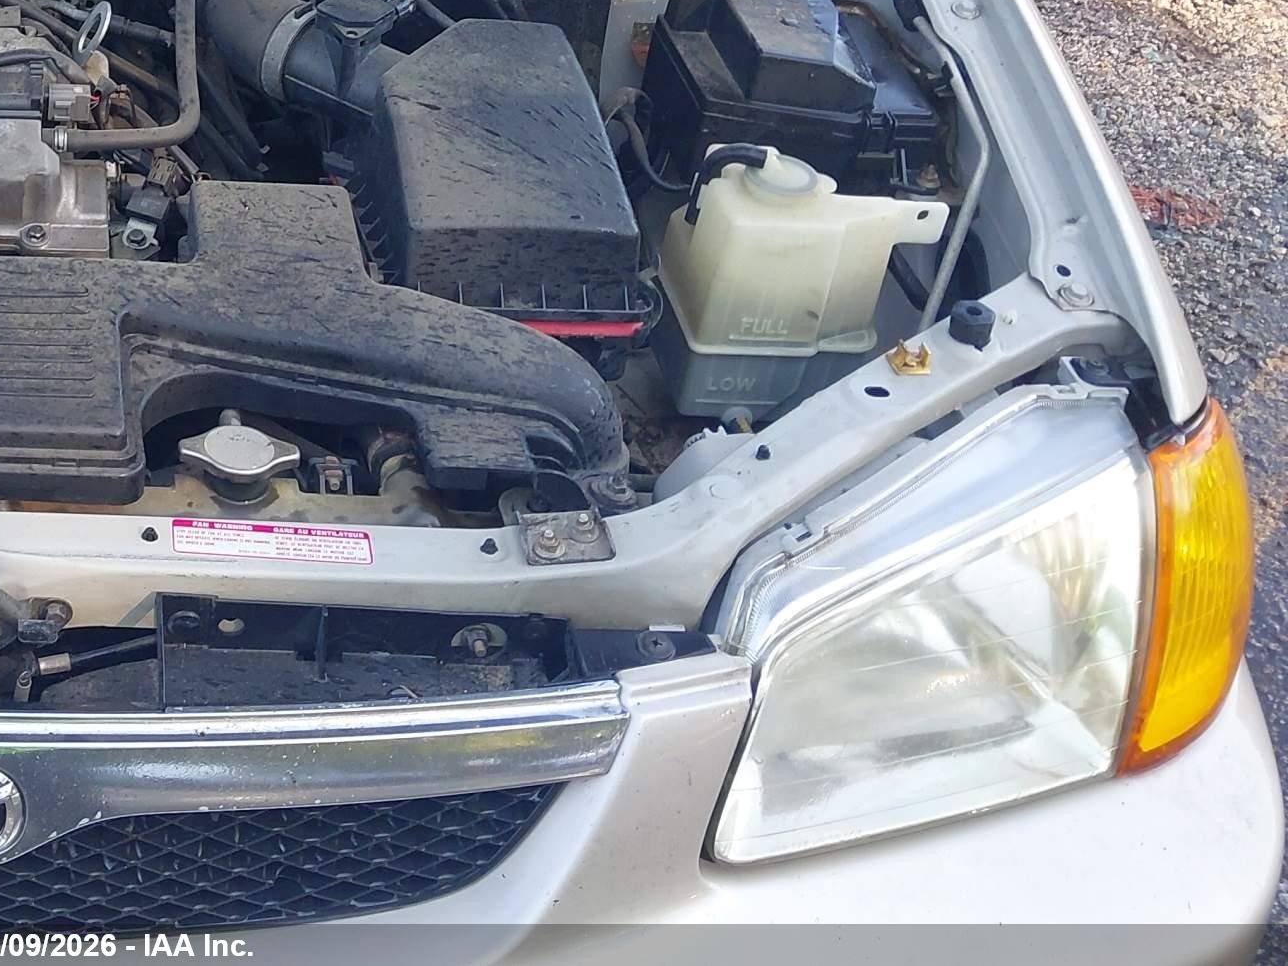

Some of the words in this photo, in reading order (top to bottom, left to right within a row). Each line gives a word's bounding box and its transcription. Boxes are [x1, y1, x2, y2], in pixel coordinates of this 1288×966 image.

[740, 317, 789, 335] FULL
[705, 376, 756, 392] LOW
[192, 521, 209, 529] FAN
[214, 522, 254, 531] WARNING
[311, 528, 365, 539] VENTILATEUR
